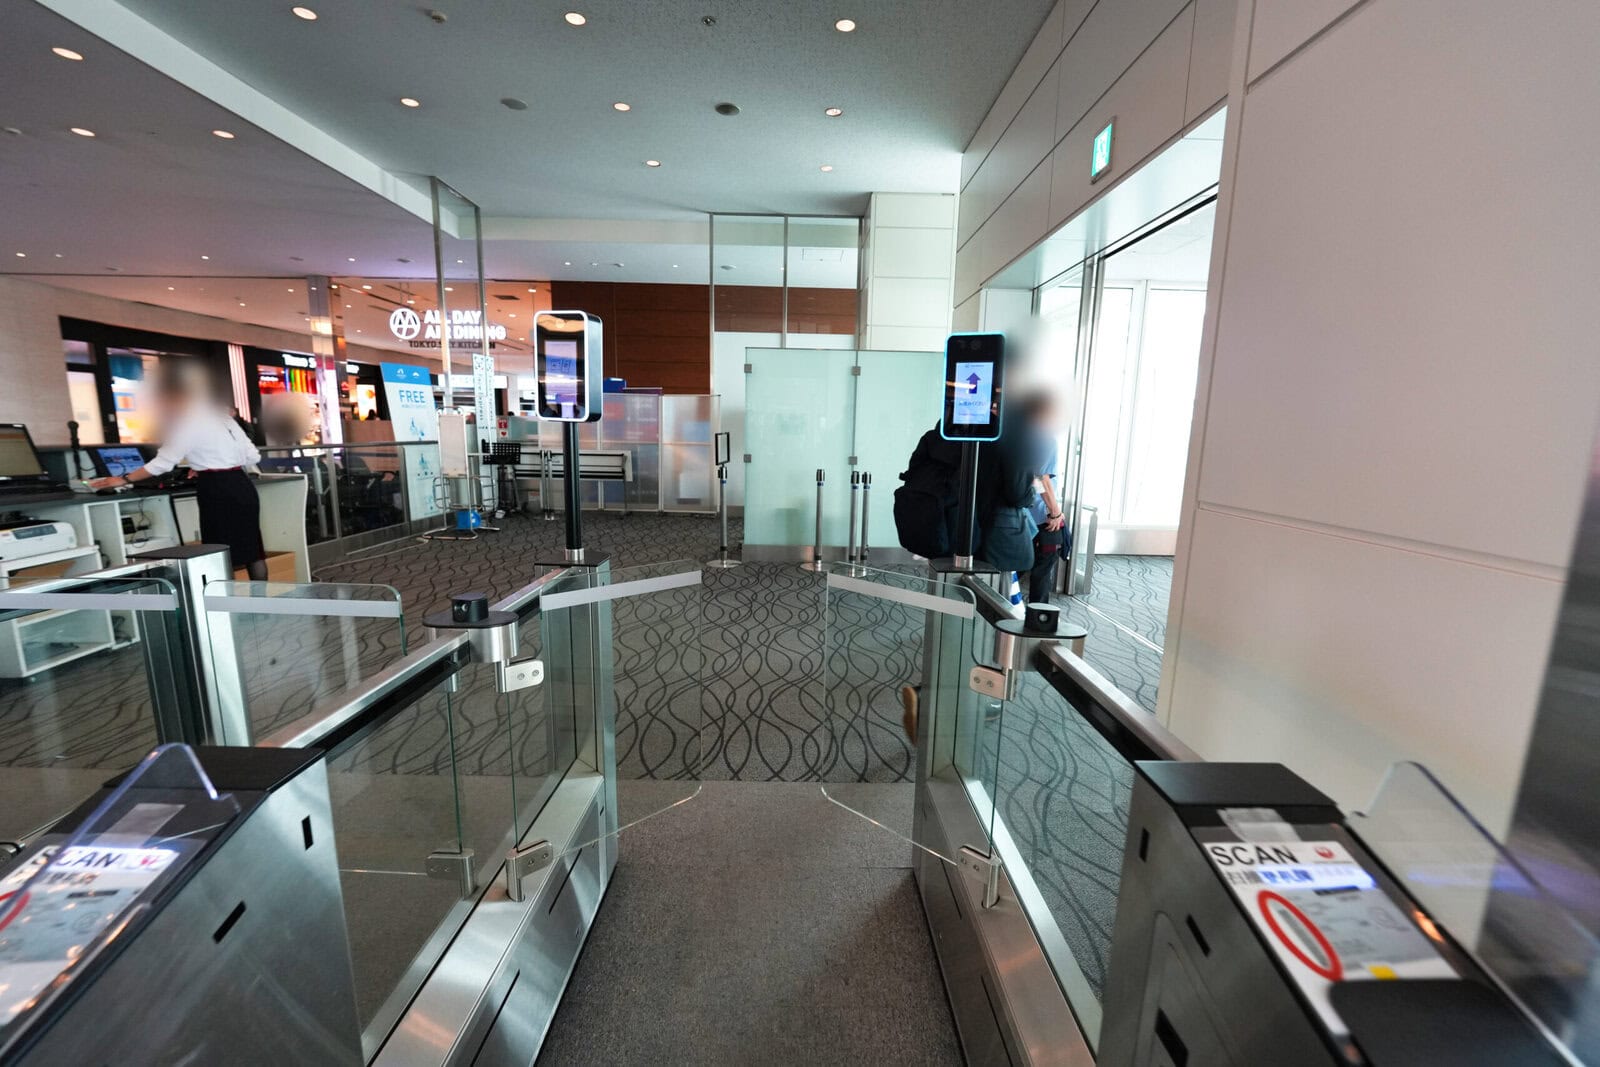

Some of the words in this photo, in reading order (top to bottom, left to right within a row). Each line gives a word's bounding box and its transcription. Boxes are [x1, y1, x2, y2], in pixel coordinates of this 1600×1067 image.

[452, 310, 482, 325] DAY
[453, 325, 507, 340] DINING
[458, 341, 496, 349] KITCHN
[399, 390, 426, 403] FREE
[1211, 845, 1299, 866] SCAN
